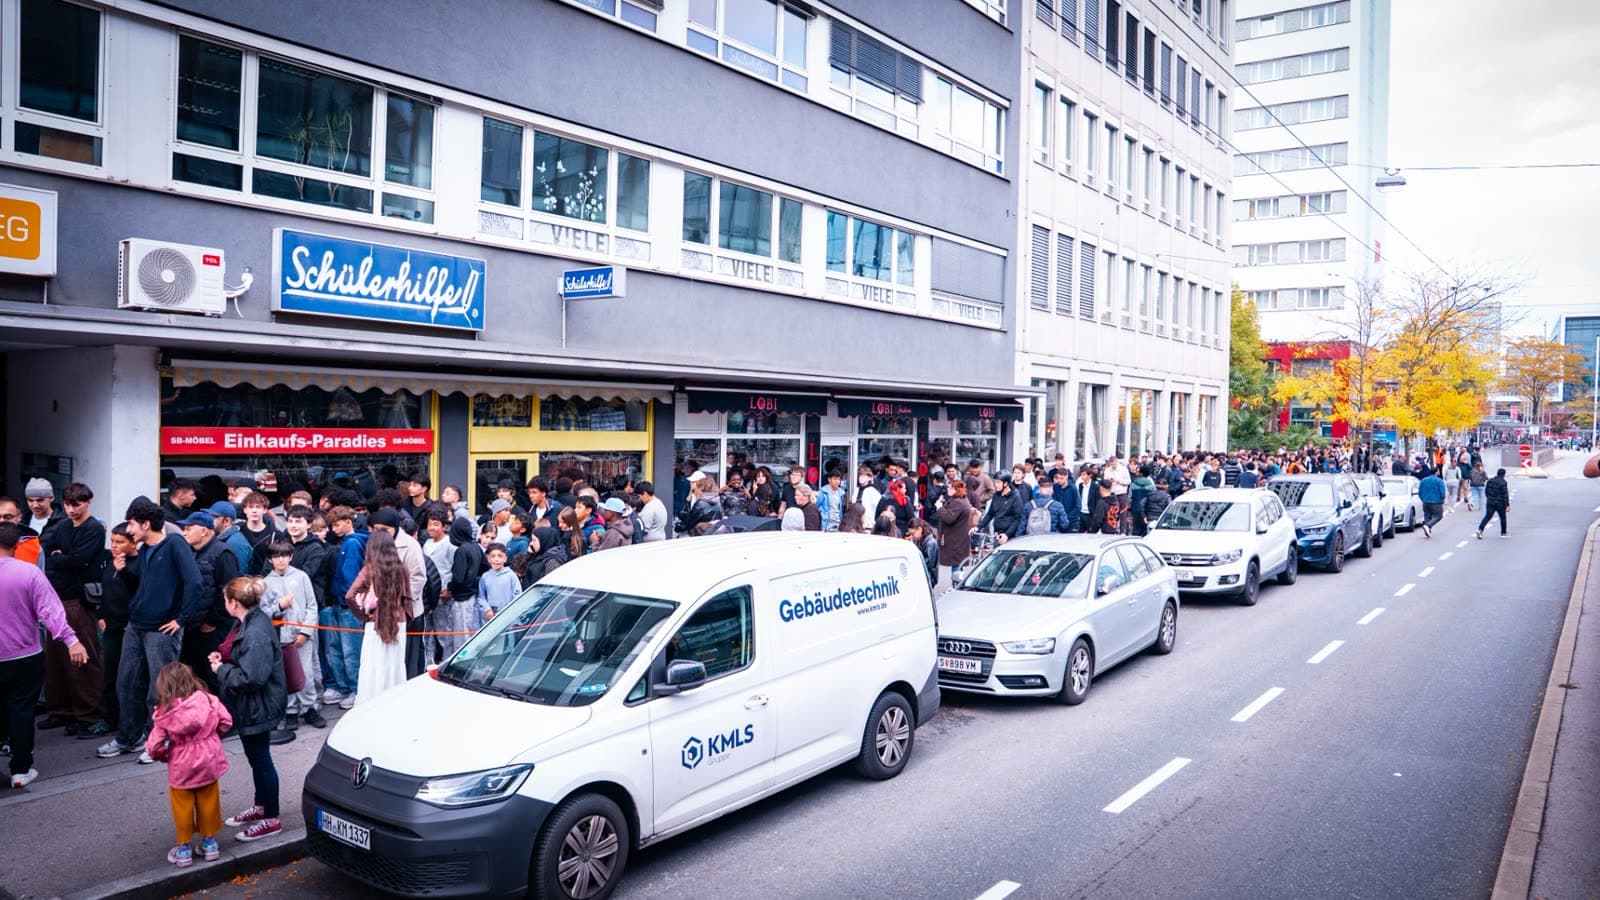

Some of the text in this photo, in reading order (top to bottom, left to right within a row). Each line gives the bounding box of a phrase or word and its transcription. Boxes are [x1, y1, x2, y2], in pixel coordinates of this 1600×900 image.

[551, 225, 606, 253] VIELE
[732, 258, 770, 282] VIELE
[862, 284, 892, 305] VIELE
[958, 303, 983, 321] VIELE
[750, 397, 778, 411] LOBI
[871, 402, 893, 415] LOBI
[979, 407, 996, 418] LOBI
[170, 433, 427, 449] SB-MÖBEL Einkaufs-Paradies SB-MÖBEL
[779, 576, 900, 623] Gebäudetechnik
[707, 724, 755, 757] KMLS
[349, 824, 369, 847] 1337
